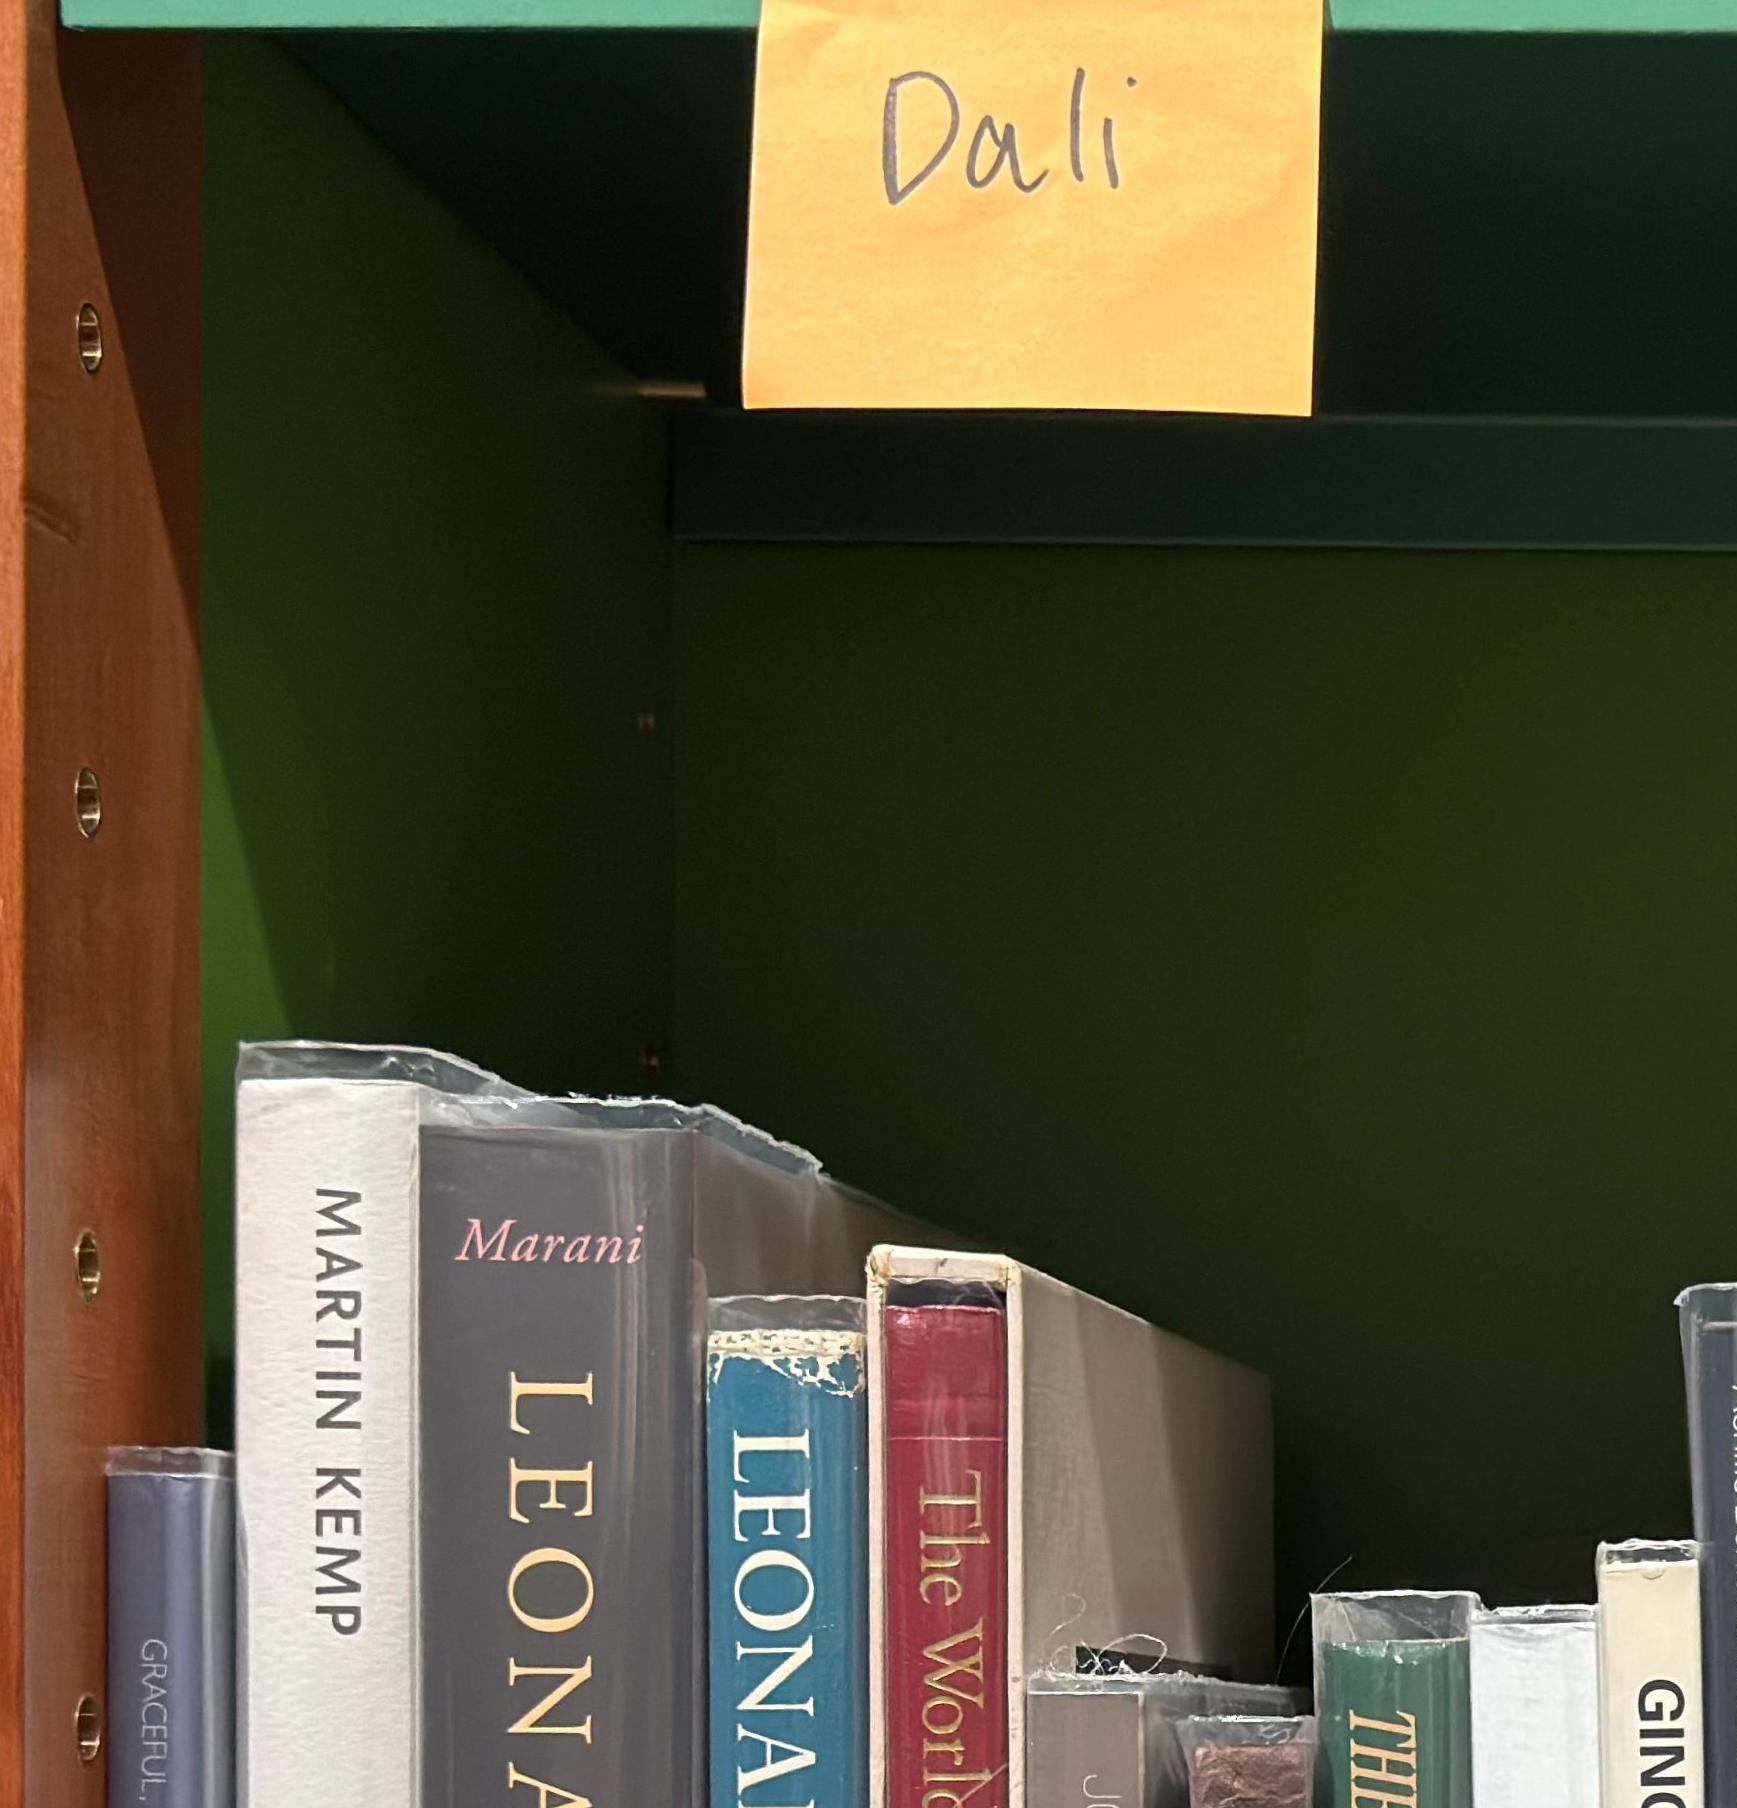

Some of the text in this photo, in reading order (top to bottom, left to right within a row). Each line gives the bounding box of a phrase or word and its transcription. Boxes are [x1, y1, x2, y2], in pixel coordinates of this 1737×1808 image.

[883, 67, 1138, 205] Dali
[454, 1218, 644, 1264] Marani
[316, 1187, 362, 1636] MARTIN KEMP
[917, 1469, 990, 1605] The
[138, 1639, 169, 1801] GRACEFUL,
